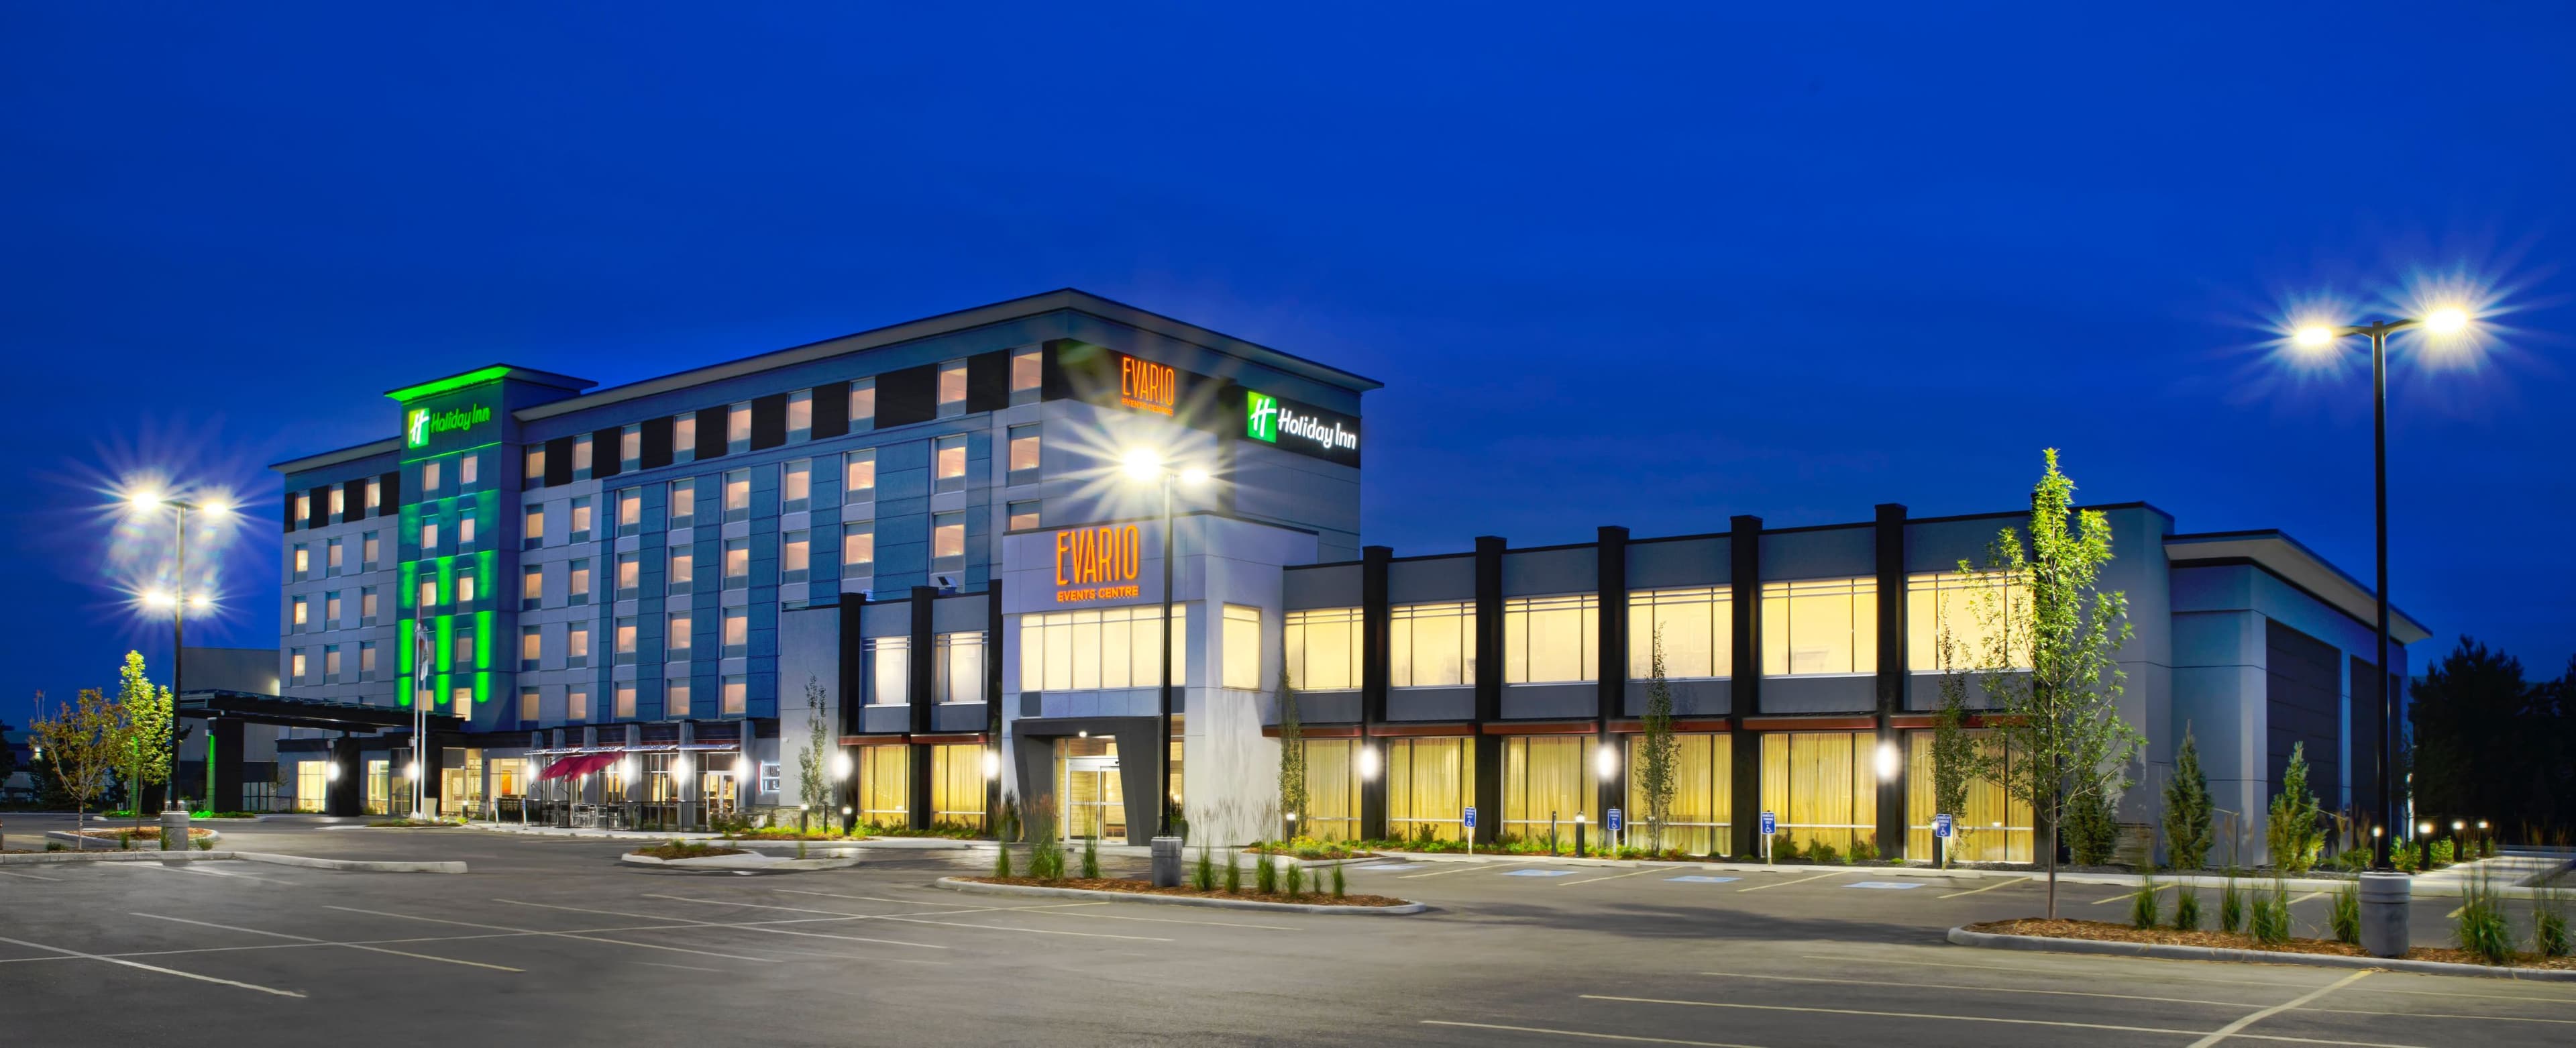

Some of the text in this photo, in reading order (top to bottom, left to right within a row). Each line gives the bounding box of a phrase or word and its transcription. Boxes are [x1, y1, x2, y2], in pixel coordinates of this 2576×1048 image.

[1123, 356, 1174, 406] EVARIO
[431, 403, 490, 433] Holiday Inn
[1278, 408, 1356, 450] Holiday Inn
[1057, 525, 1138, 586] EVARIO
[1057, 585, 1139, 602] EVENTS CENTRE
